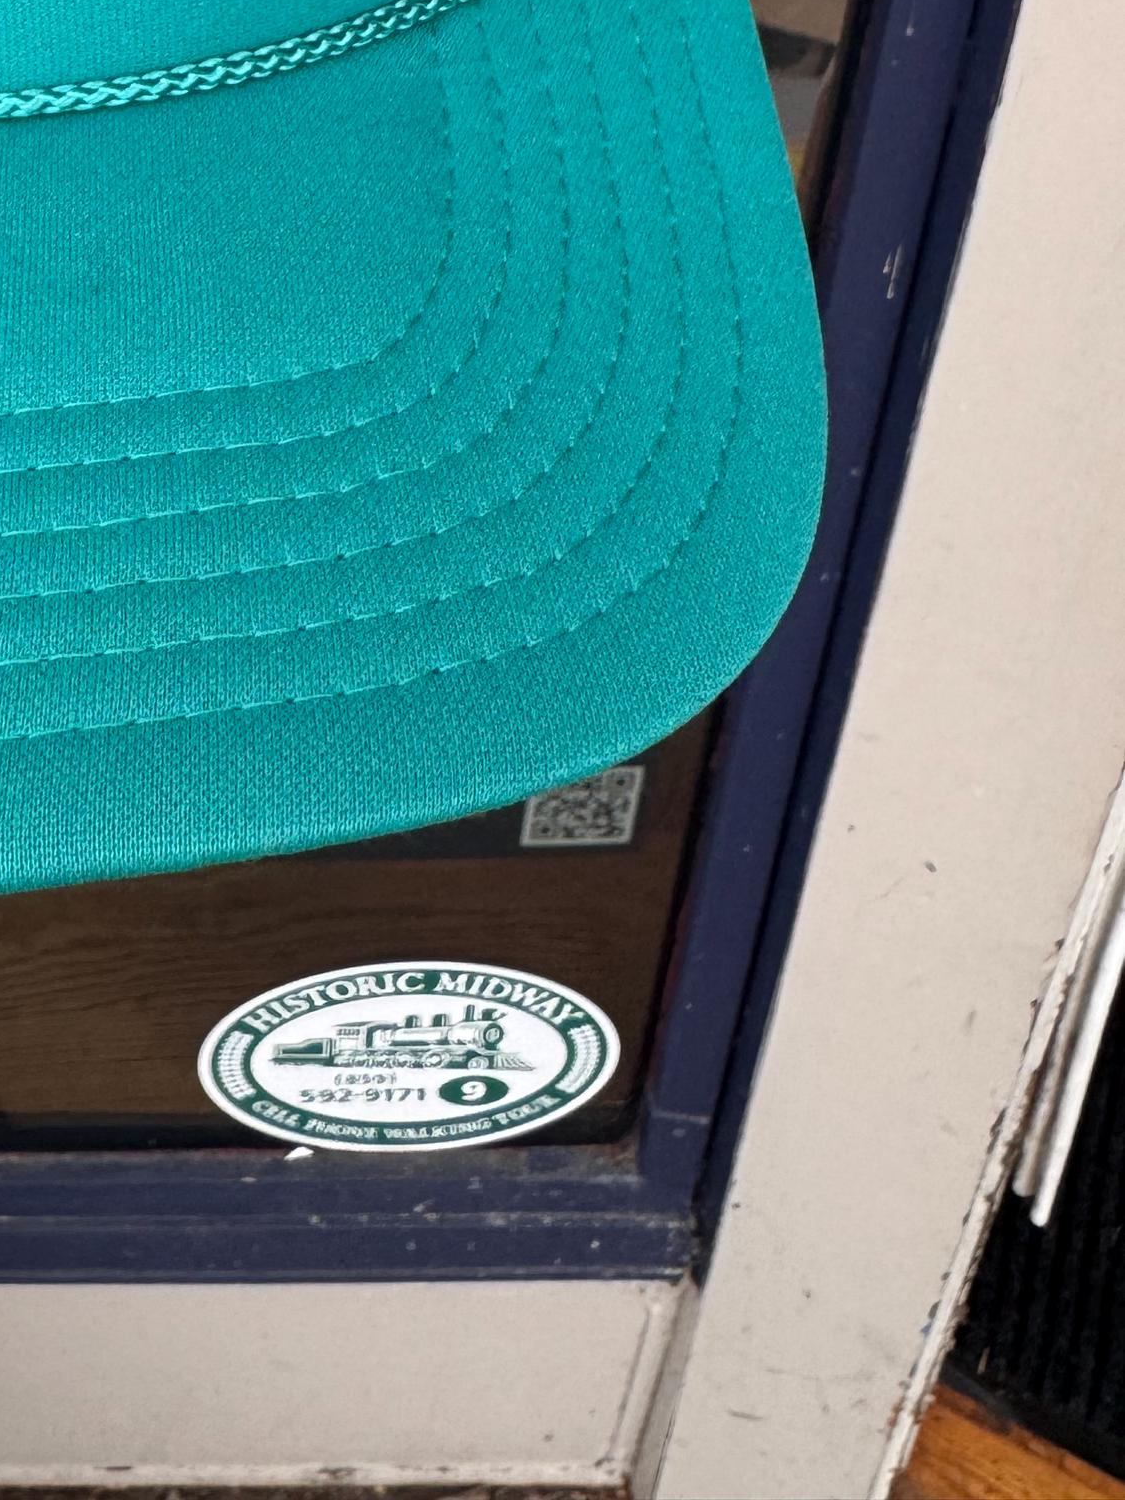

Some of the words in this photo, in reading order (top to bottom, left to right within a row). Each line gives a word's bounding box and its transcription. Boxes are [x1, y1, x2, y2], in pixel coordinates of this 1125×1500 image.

[240, 971, 427, 1034] HISTORIC
[436, 970, 584, 1026] MIDWAY
[299, 1087, 427, 1102] 592-9171
[460, 1080, 488, 1102] 9
